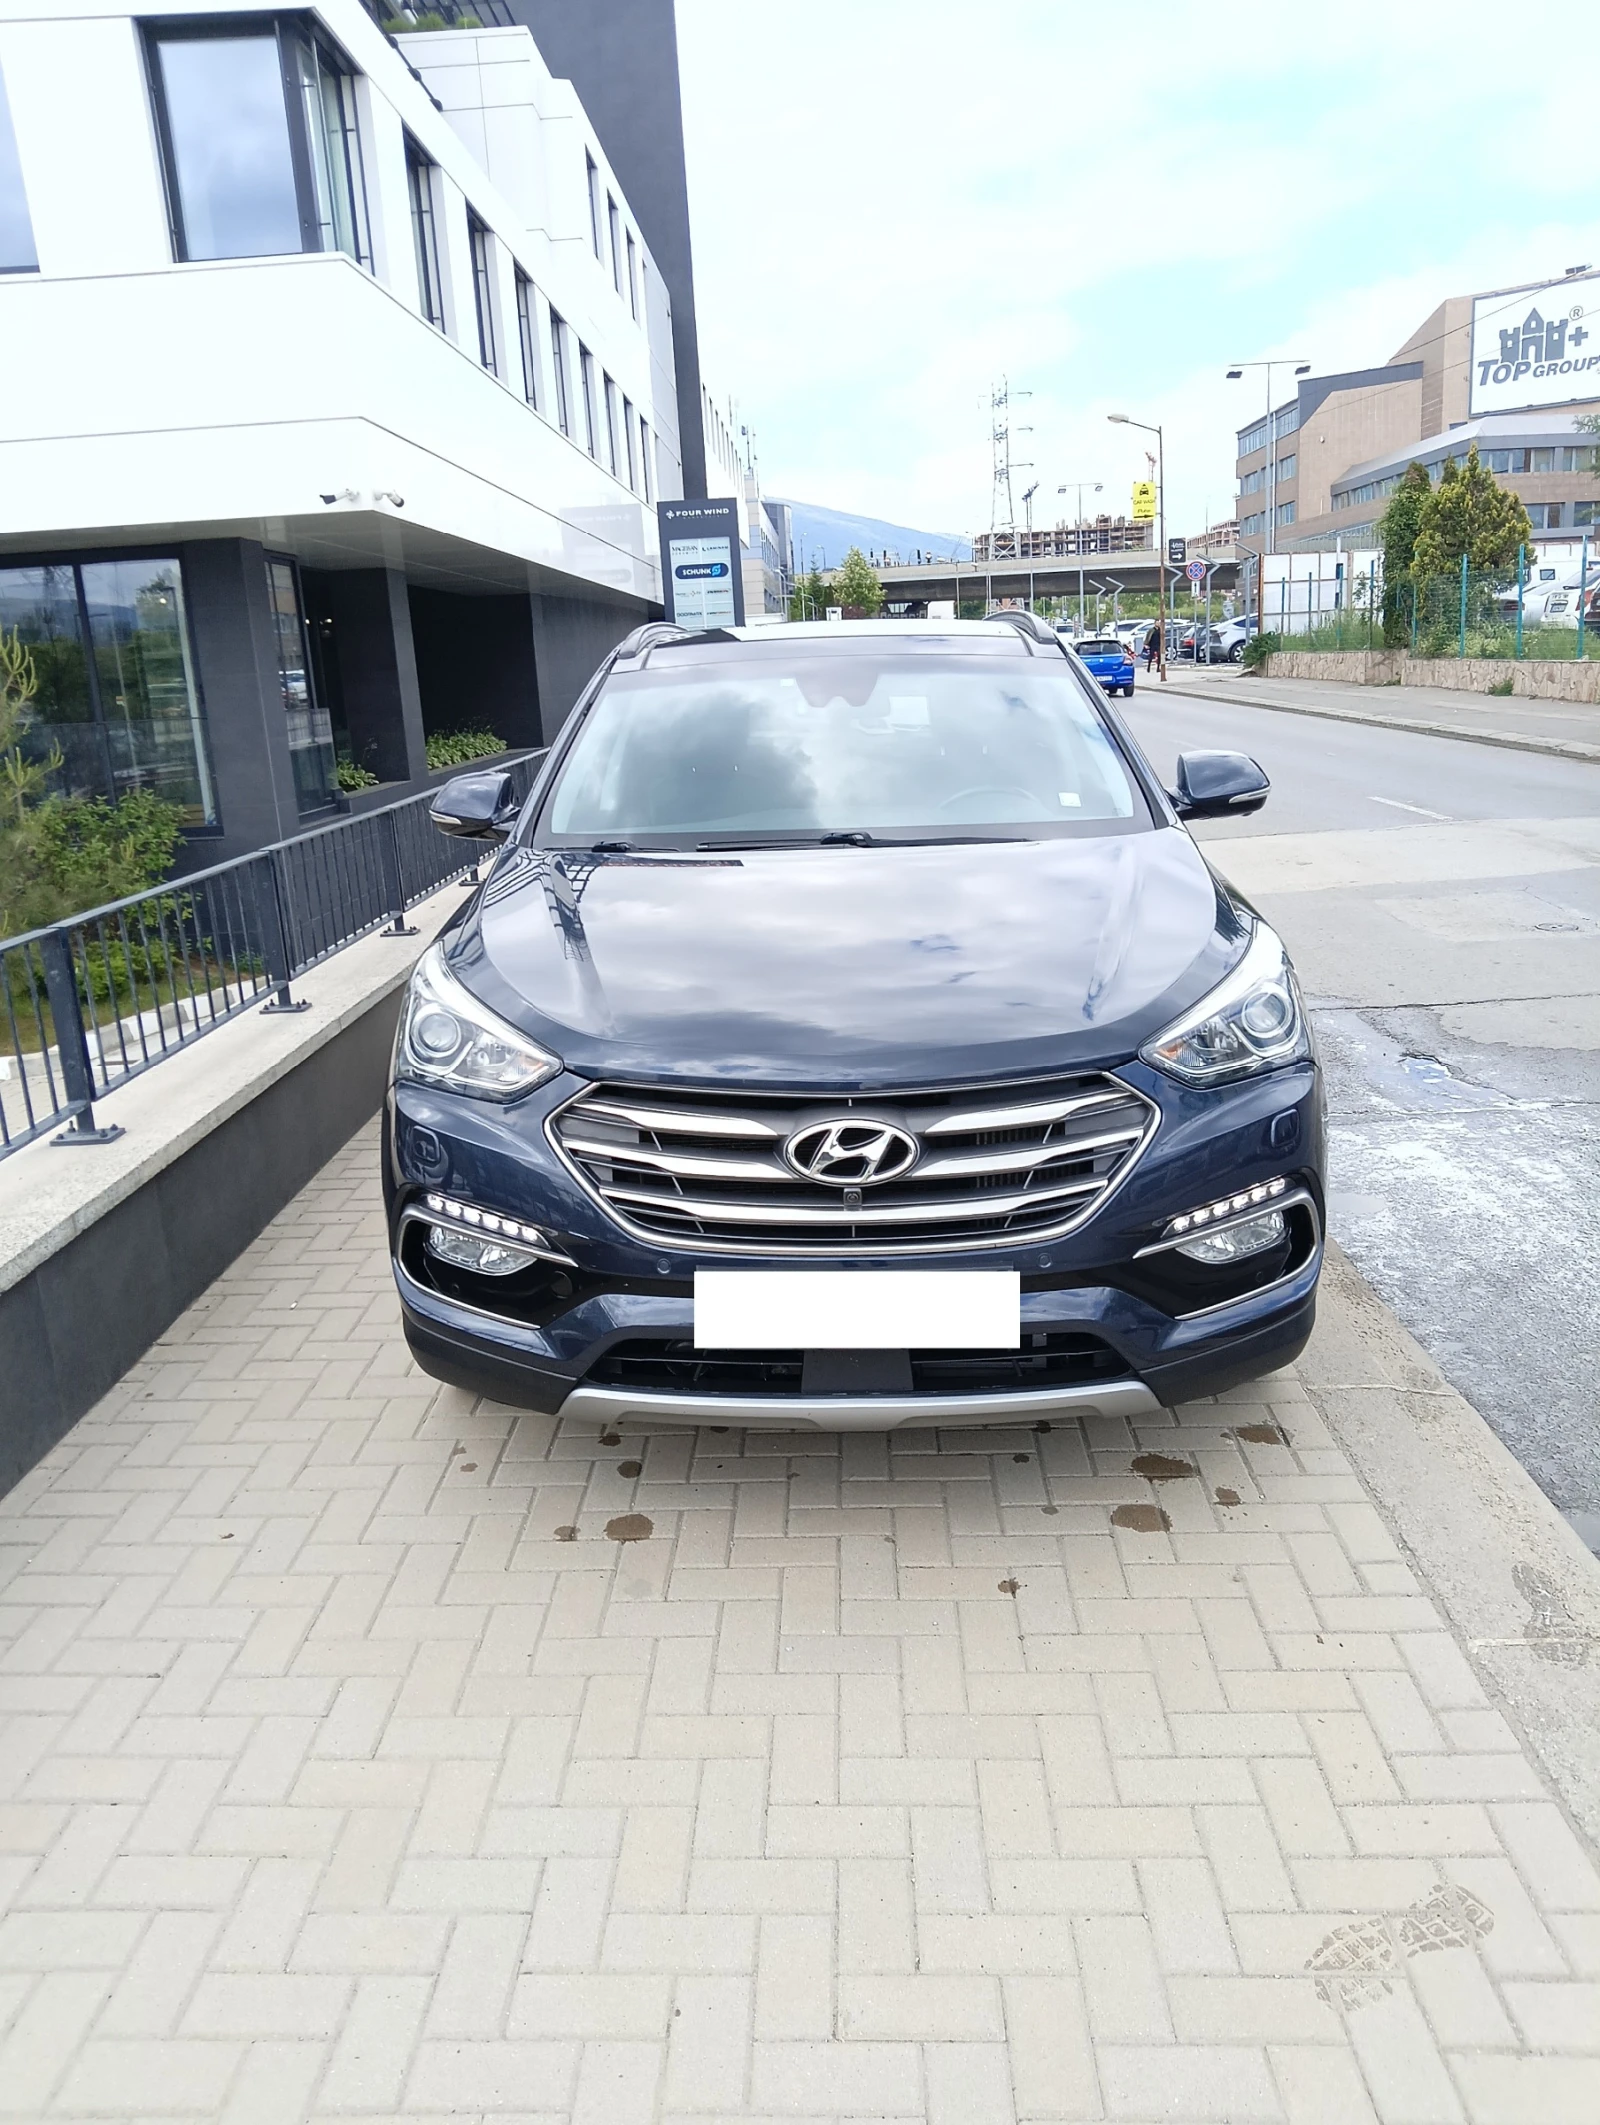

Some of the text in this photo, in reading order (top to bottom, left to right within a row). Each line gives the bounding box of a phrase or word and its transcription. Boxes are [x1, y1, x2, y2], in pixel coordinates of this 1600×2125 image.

[676, 507, 730, 517] FOUR WIND
[682, 567, 712, 576] SCHUNK
